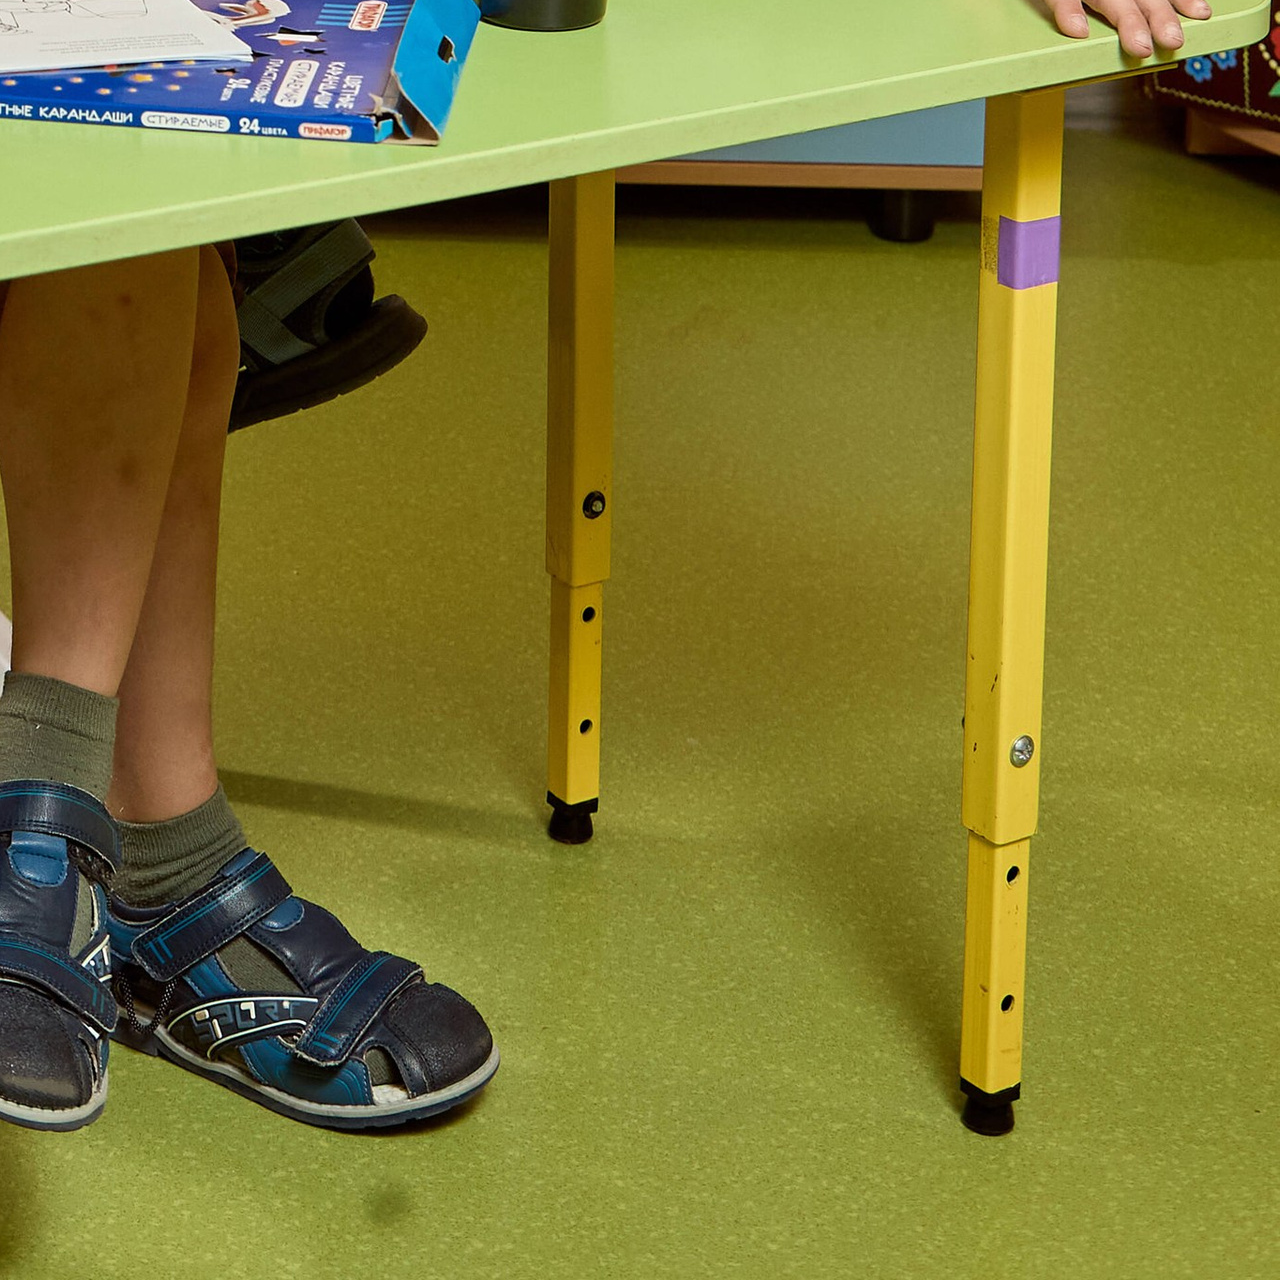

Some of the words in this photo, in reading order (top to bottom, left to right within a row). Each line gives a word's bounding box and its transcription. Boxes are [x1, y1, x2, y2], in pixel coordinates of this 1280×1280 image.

[39, 106, 133, 124] КАРАНДАШИ
[146, 115, 226, 130] СТИРАЕМЫЕ
[239, 117, 261, 134] 24
[261, 126, 288, 137] ЦВЕТА
